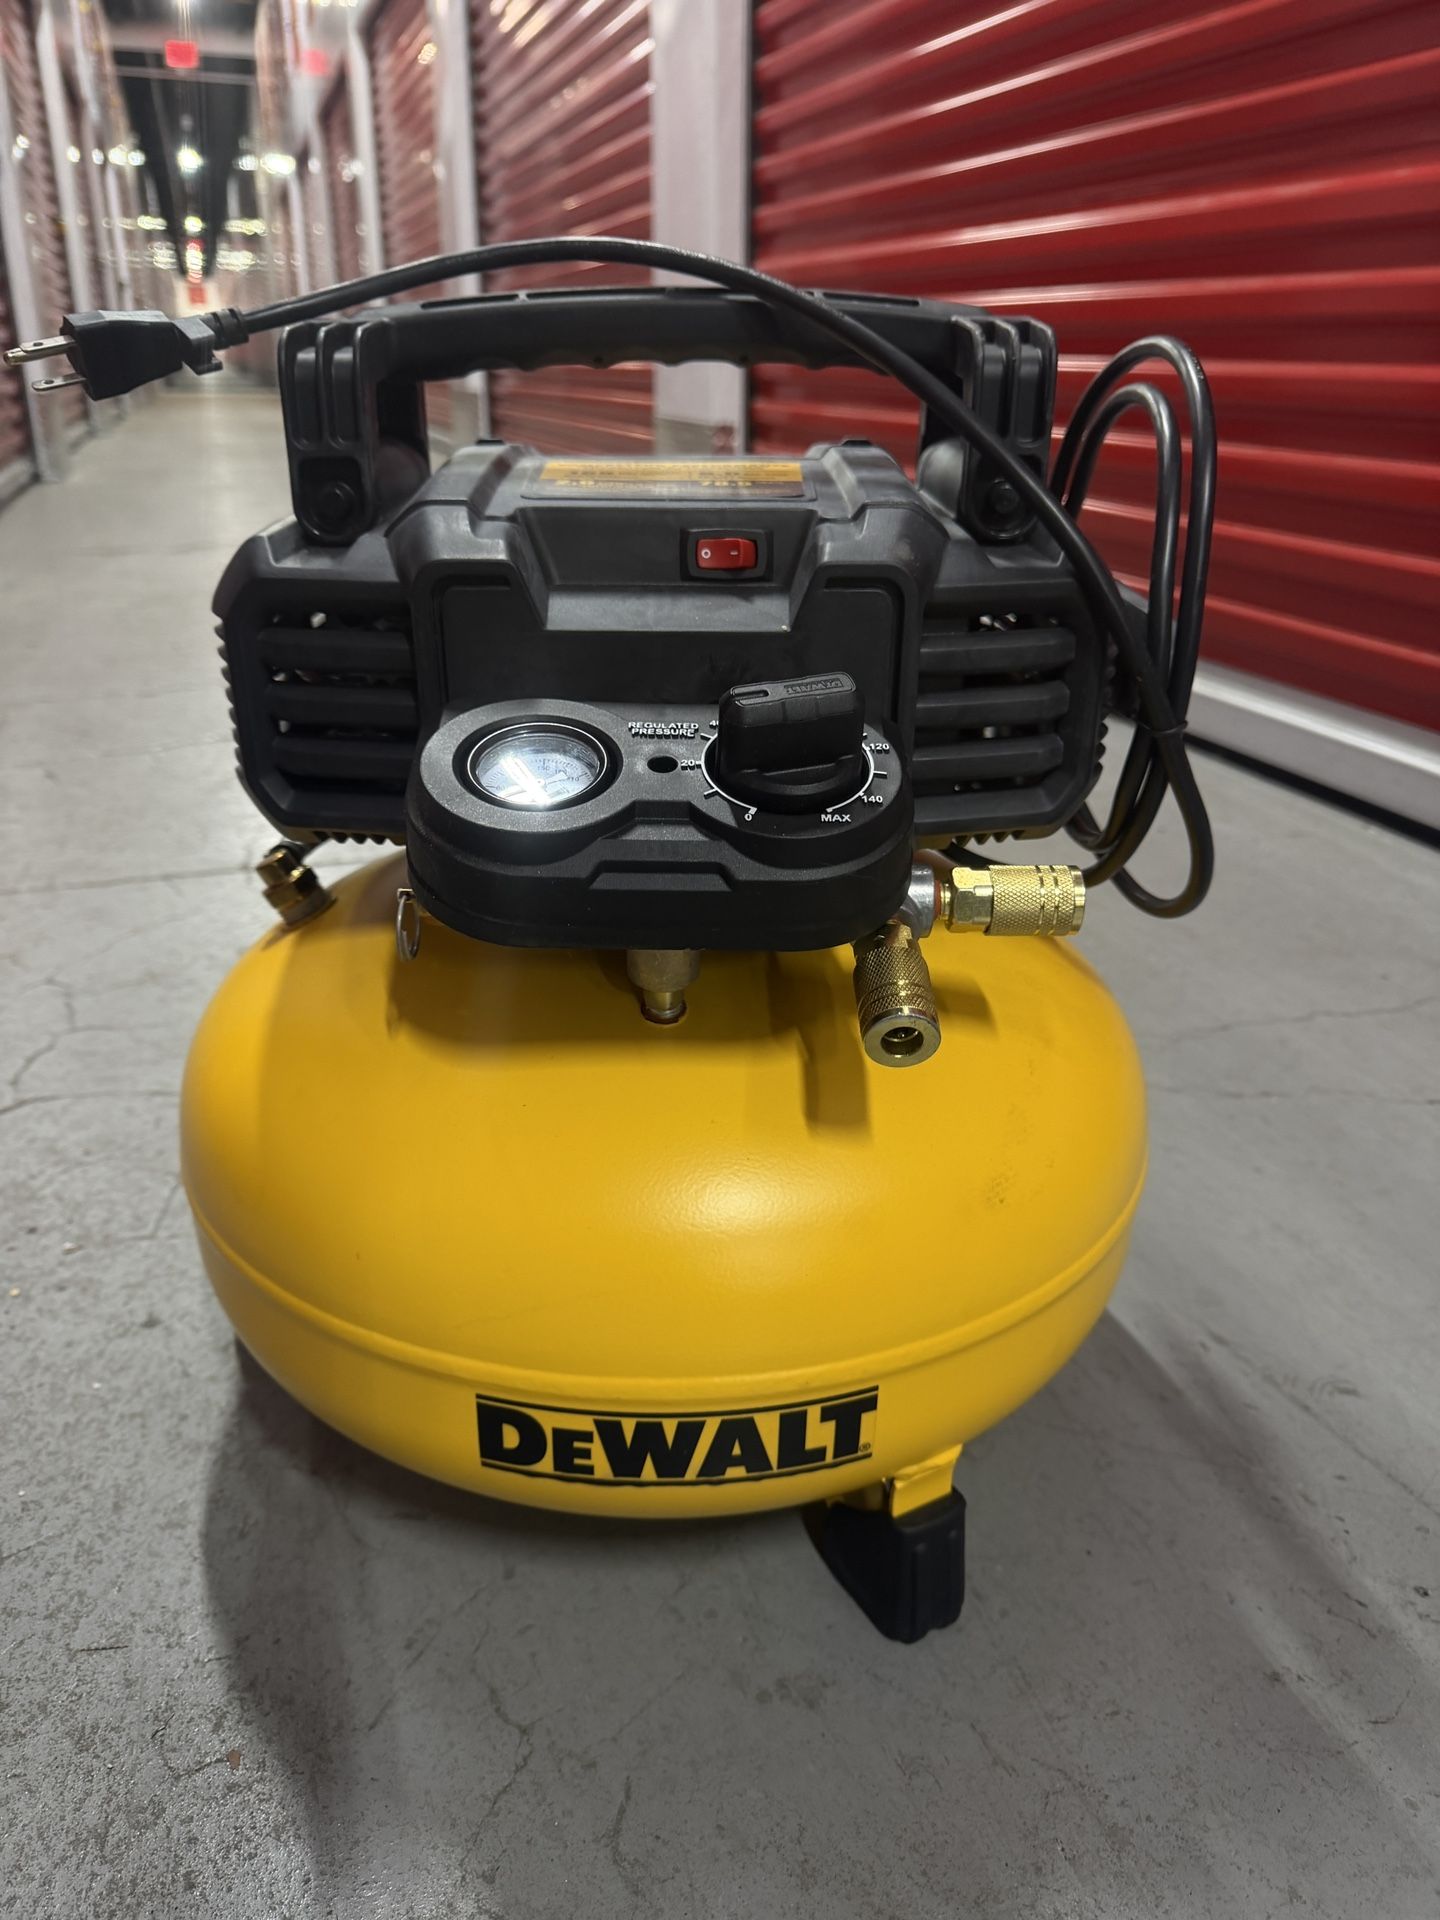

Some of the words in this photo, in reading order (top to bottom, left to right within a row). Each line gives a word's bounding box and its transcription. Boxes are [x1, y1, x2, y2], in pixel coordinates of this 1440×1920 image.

[628, 721, 699, 730] REGULATED
[631, 728, 695, 737] PRESSURE
[869, 743, 890, 751] 120
[680, 759, 696, 767] 20
[861, 795, 883, 803] 140
[744, 813, 753, 822] 0
[820, 814, 852, 823] MAX
